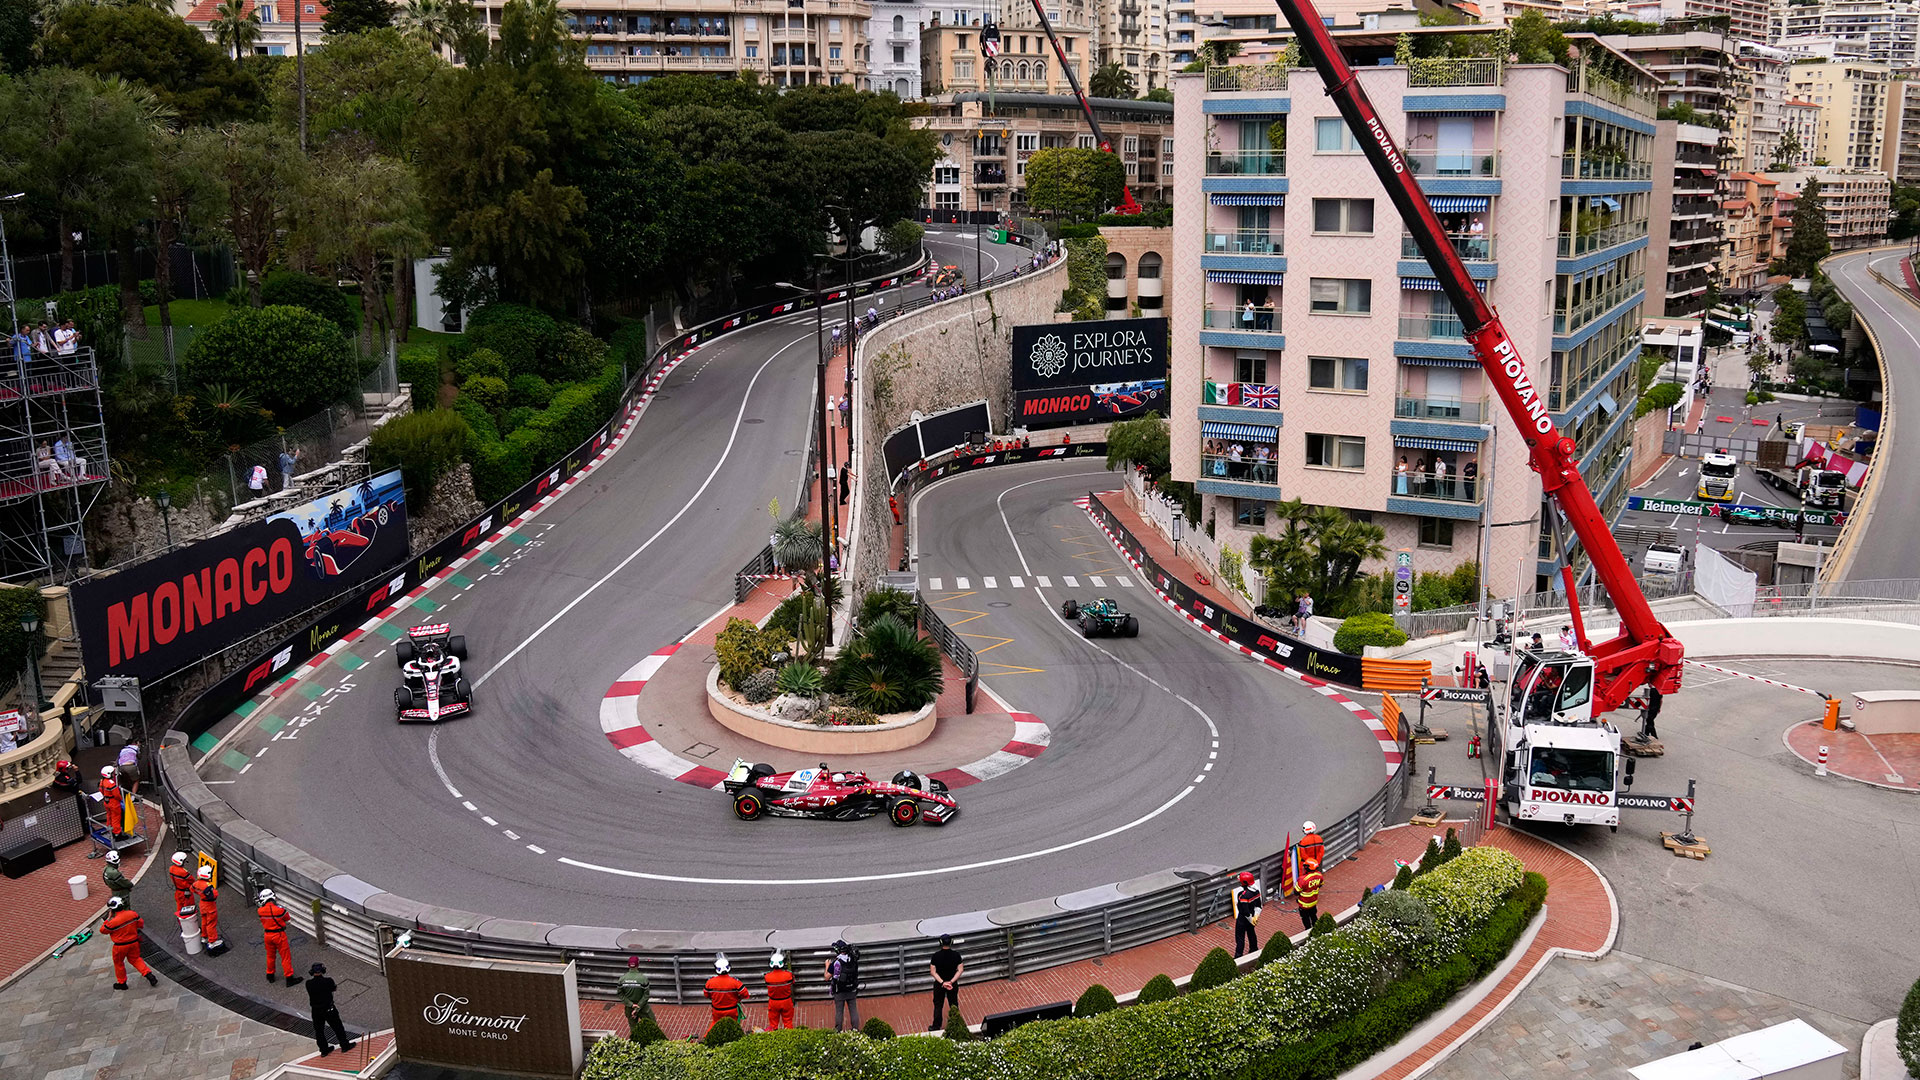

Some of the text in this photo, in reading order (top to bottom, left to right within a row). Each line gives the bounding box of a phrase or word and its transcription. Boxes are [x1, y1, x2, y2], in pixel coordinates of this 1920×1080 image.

[1367, 117, 1403, 173] PIOVANO
[1074, 331, 1147, 350] EXPLORA
[1072, 347, 1152, 373] JOURNEYS
[1493, 340, 1552, 433] PIOVANO
[1023, 395, 1090, 415] MONACO
[1643, 499, 1702, 515] Heineken
[107, 537, 293, 668] MONACO
[1307, 651, 1341, 675] Monaco
[281, 684, 357, 739] TAXIS
[822, 796, 837, 807] 75
[1532, 789, 1609, 805] PIOVANO
[1618, 798, 1667, 808] PIOVANO
[423, 993, 529, 1033] Fairmont
[449, 1028, 508, 1040] MONTE CARLO
